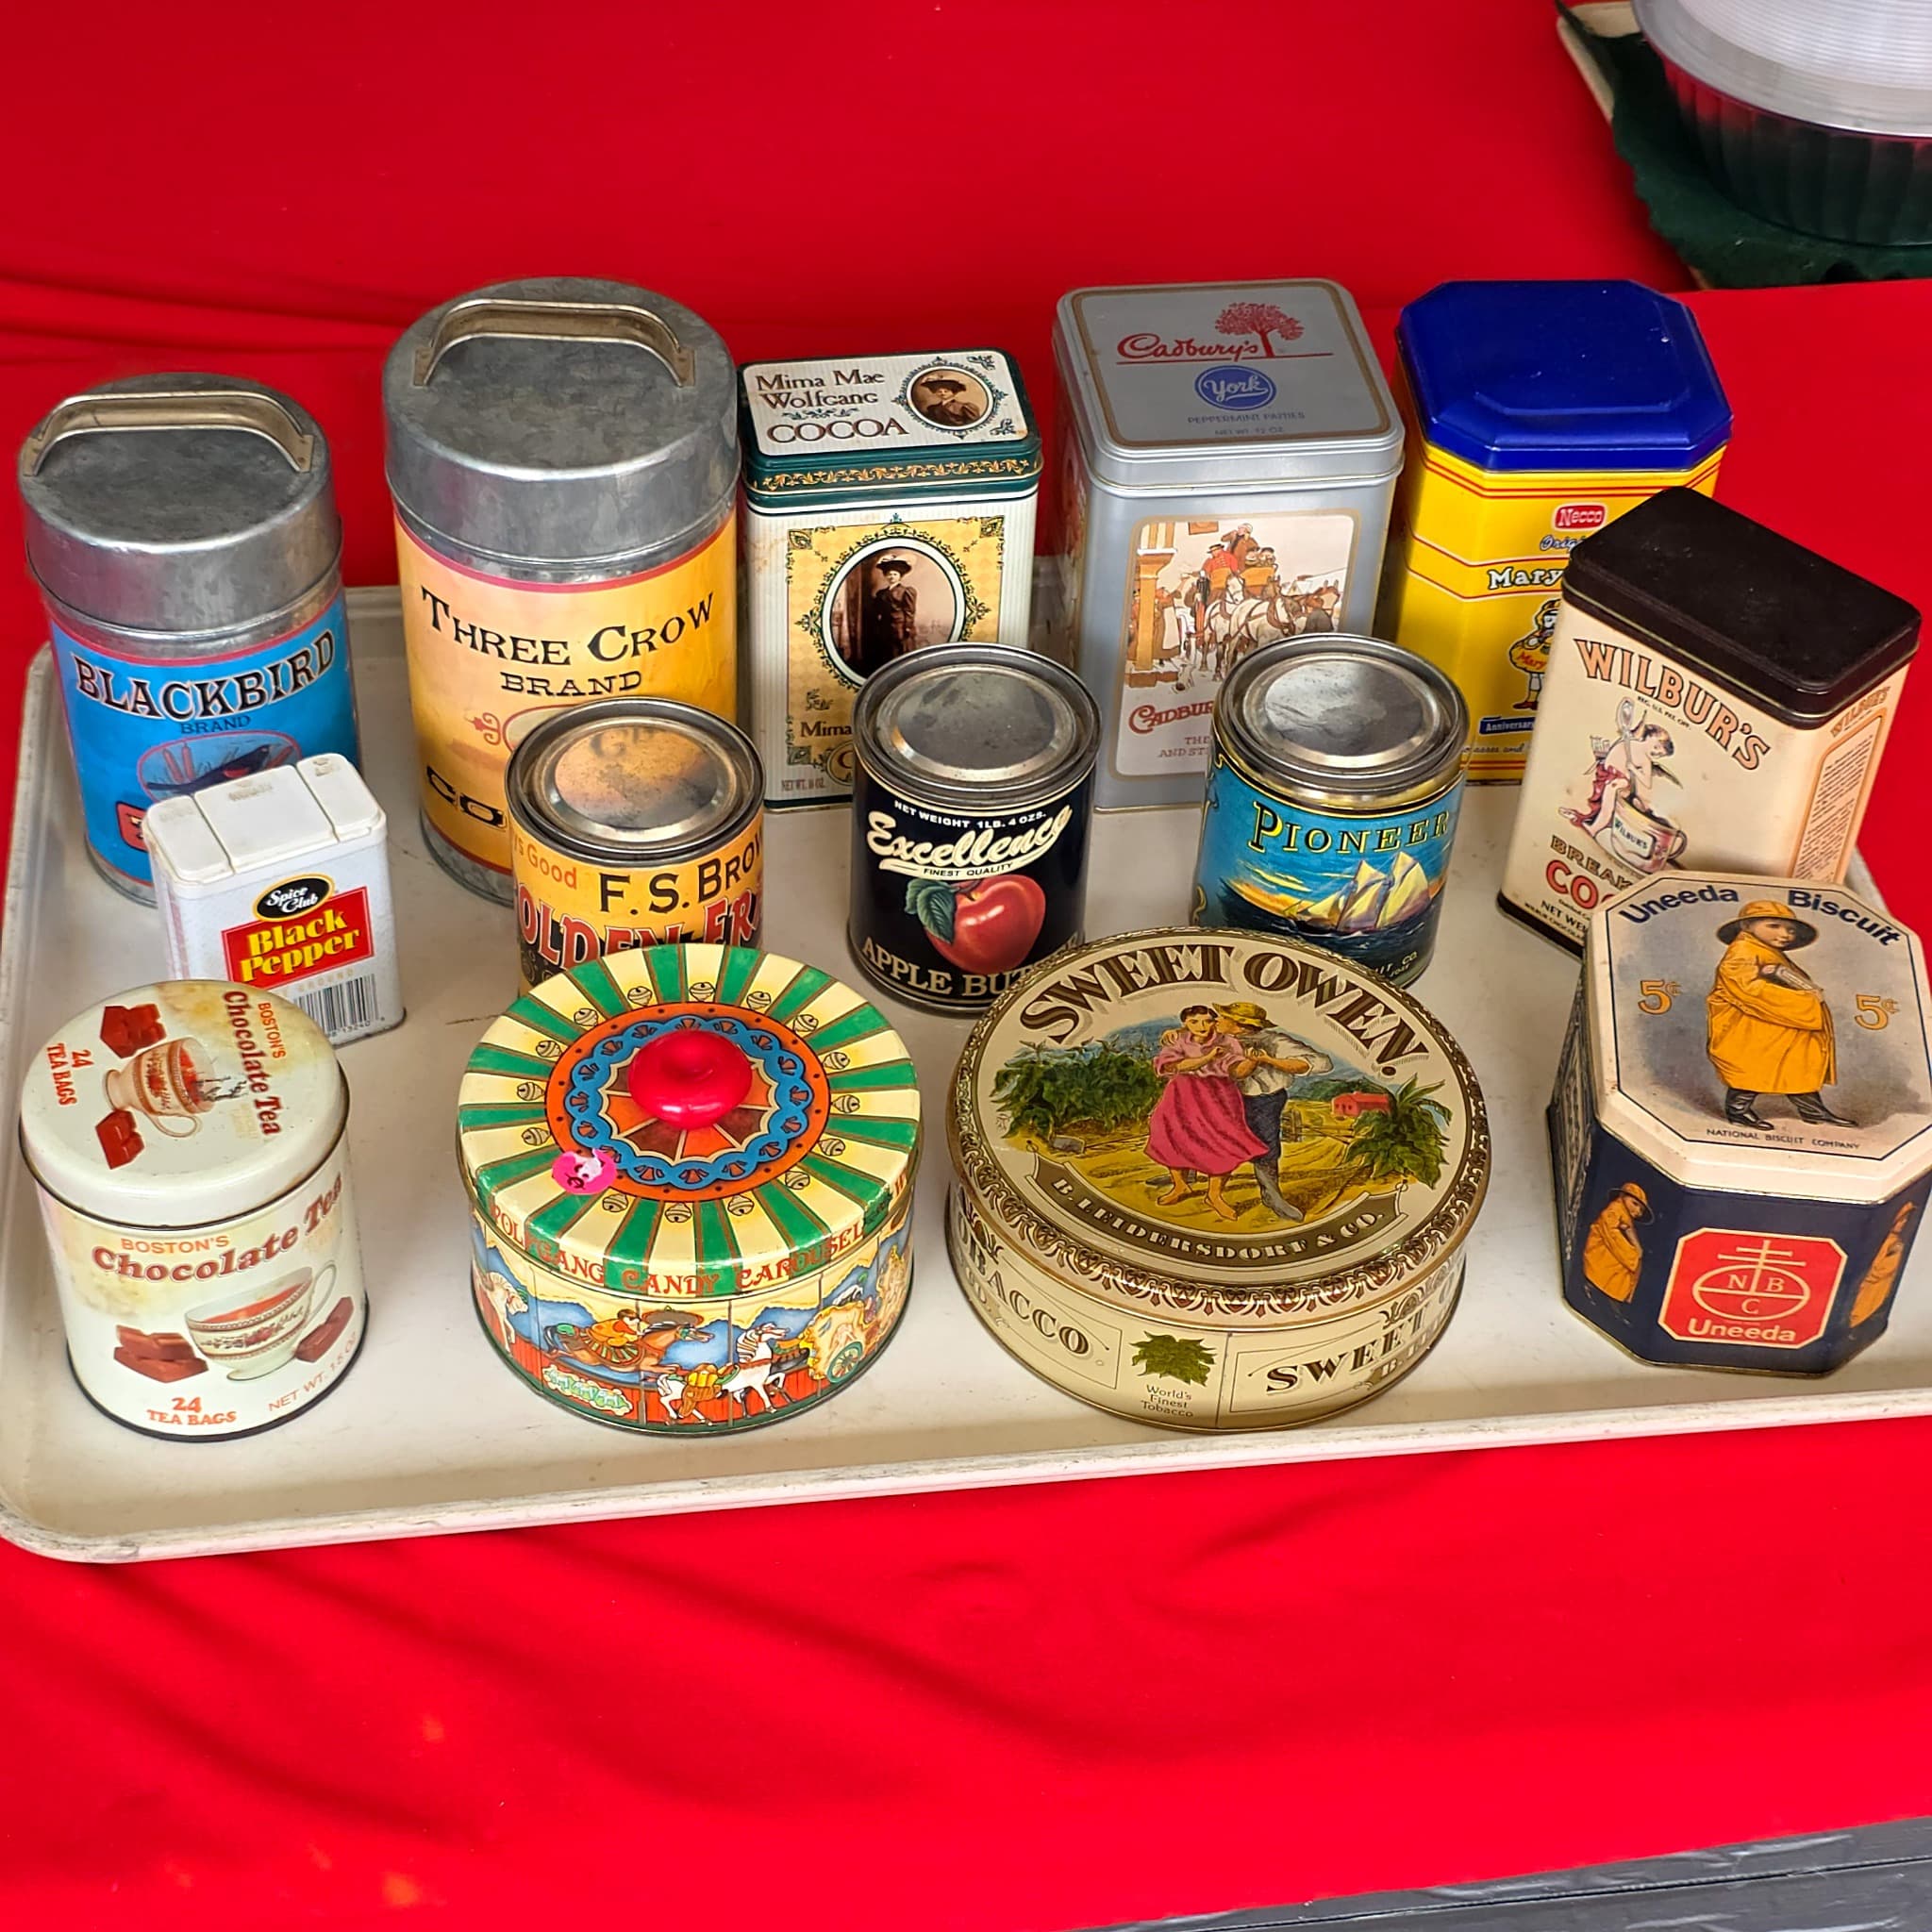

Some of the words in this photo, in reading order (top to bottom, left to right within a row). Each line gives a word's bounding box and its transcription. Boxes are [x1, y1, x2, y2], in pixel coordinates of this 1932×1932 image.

[1117, 333, 1258, 362] Cadbury's
[756, 372, 826, 391] Mima
[833, 368, 885, 387] Mae
[1204, 375, 1270, 402] York
[767, 418, 910, 443] COCOA
[1557, 508, 1603, 527] Necco
[1488, 565, 1564, 590] Mary
[421, 586, 572, 666] THREE
[587, 591, 714, 662] CROW
[71, 628, 336, 721] BLACKBIRD
[500, 669, 643, 697] BRAND
[1574, 638, 1771, 771] WILBUR'S
[179, 713, 252, 736] BRAND
[800, 722, 852, 738] Mima
[1485, 721, 1535, 732] Anniversar
[894, 800, 917, 819] NET
[919, 811, 971, 828] WEIGHT
[1008, 817, 1017, 827] 4
[1247, 800, 1450, 854] PIONEER
[527, 843, 577, 891] Good
[924, 867, 960, 877] FINEST
[966, 862, 1014, 877] QUALITY
[266, 886, 308, 908] Spice
[1545, 859, 1616, 910] CO
[282, 893, 319, 914] Club
[1619, 884, 1739, 924] Uneeda
[1789, 889, 1902, 947] Biscuit
[247, 908, 349, 958] Black
[239, 927, 360, 983] Pepper
[862, 935, 954, 997] APPLE
[1020, 944, 1236, 1045] SWEET
[258, 1002, 287, 1060] BOSTON'S
[47, 1042, 69, 1074] TEA
[72, 1049, 95, 1070] 24
[223, 991, 270, 1094] Chocolate
[253, 1094, 284, 1137] Tea
[53, 1073, 78, 1108] BAGS
[1706, 1128, 1759, 1141] NATIONAL
[1765, 1133, 1805, 1145] BISCUIT
[1811, 1138, 1861, 1151] COMPANY
[92, 1225, 299, 1282] Chocolate
[304, 1173, 342, 1237] Tea
[1051, 1178, 1074, 1202] B.
[1077, 1198, 1310, 1261] LEIDERSDORF
[1316, 1233, 1337, 1248] &
[1339, 1211, 1387, 1239] CO.
[121, 1235, 229, 1255] BOSTON'S
[621, 1268, 720, 1296] CANDY
[1727, 1274, 1748, 1291] N
[1765, 1276, 1786, 1292] B
[1740, 1298, 1760, 1315] C
[1687, 1317, 1797, 1342] Uneeda
[172, 1396, 202, 1413] 24
[268, 1388, 299, 1412] NET
[1146, 1384, 1192, 1401] World's
[1150, 1393, 1188, 1408] Finest
[146, 1409, 183, 1425] TEA
[187, 1410, 237, 1425] BAGS
[1141, 1399, 1194, 1418] Tobacco
